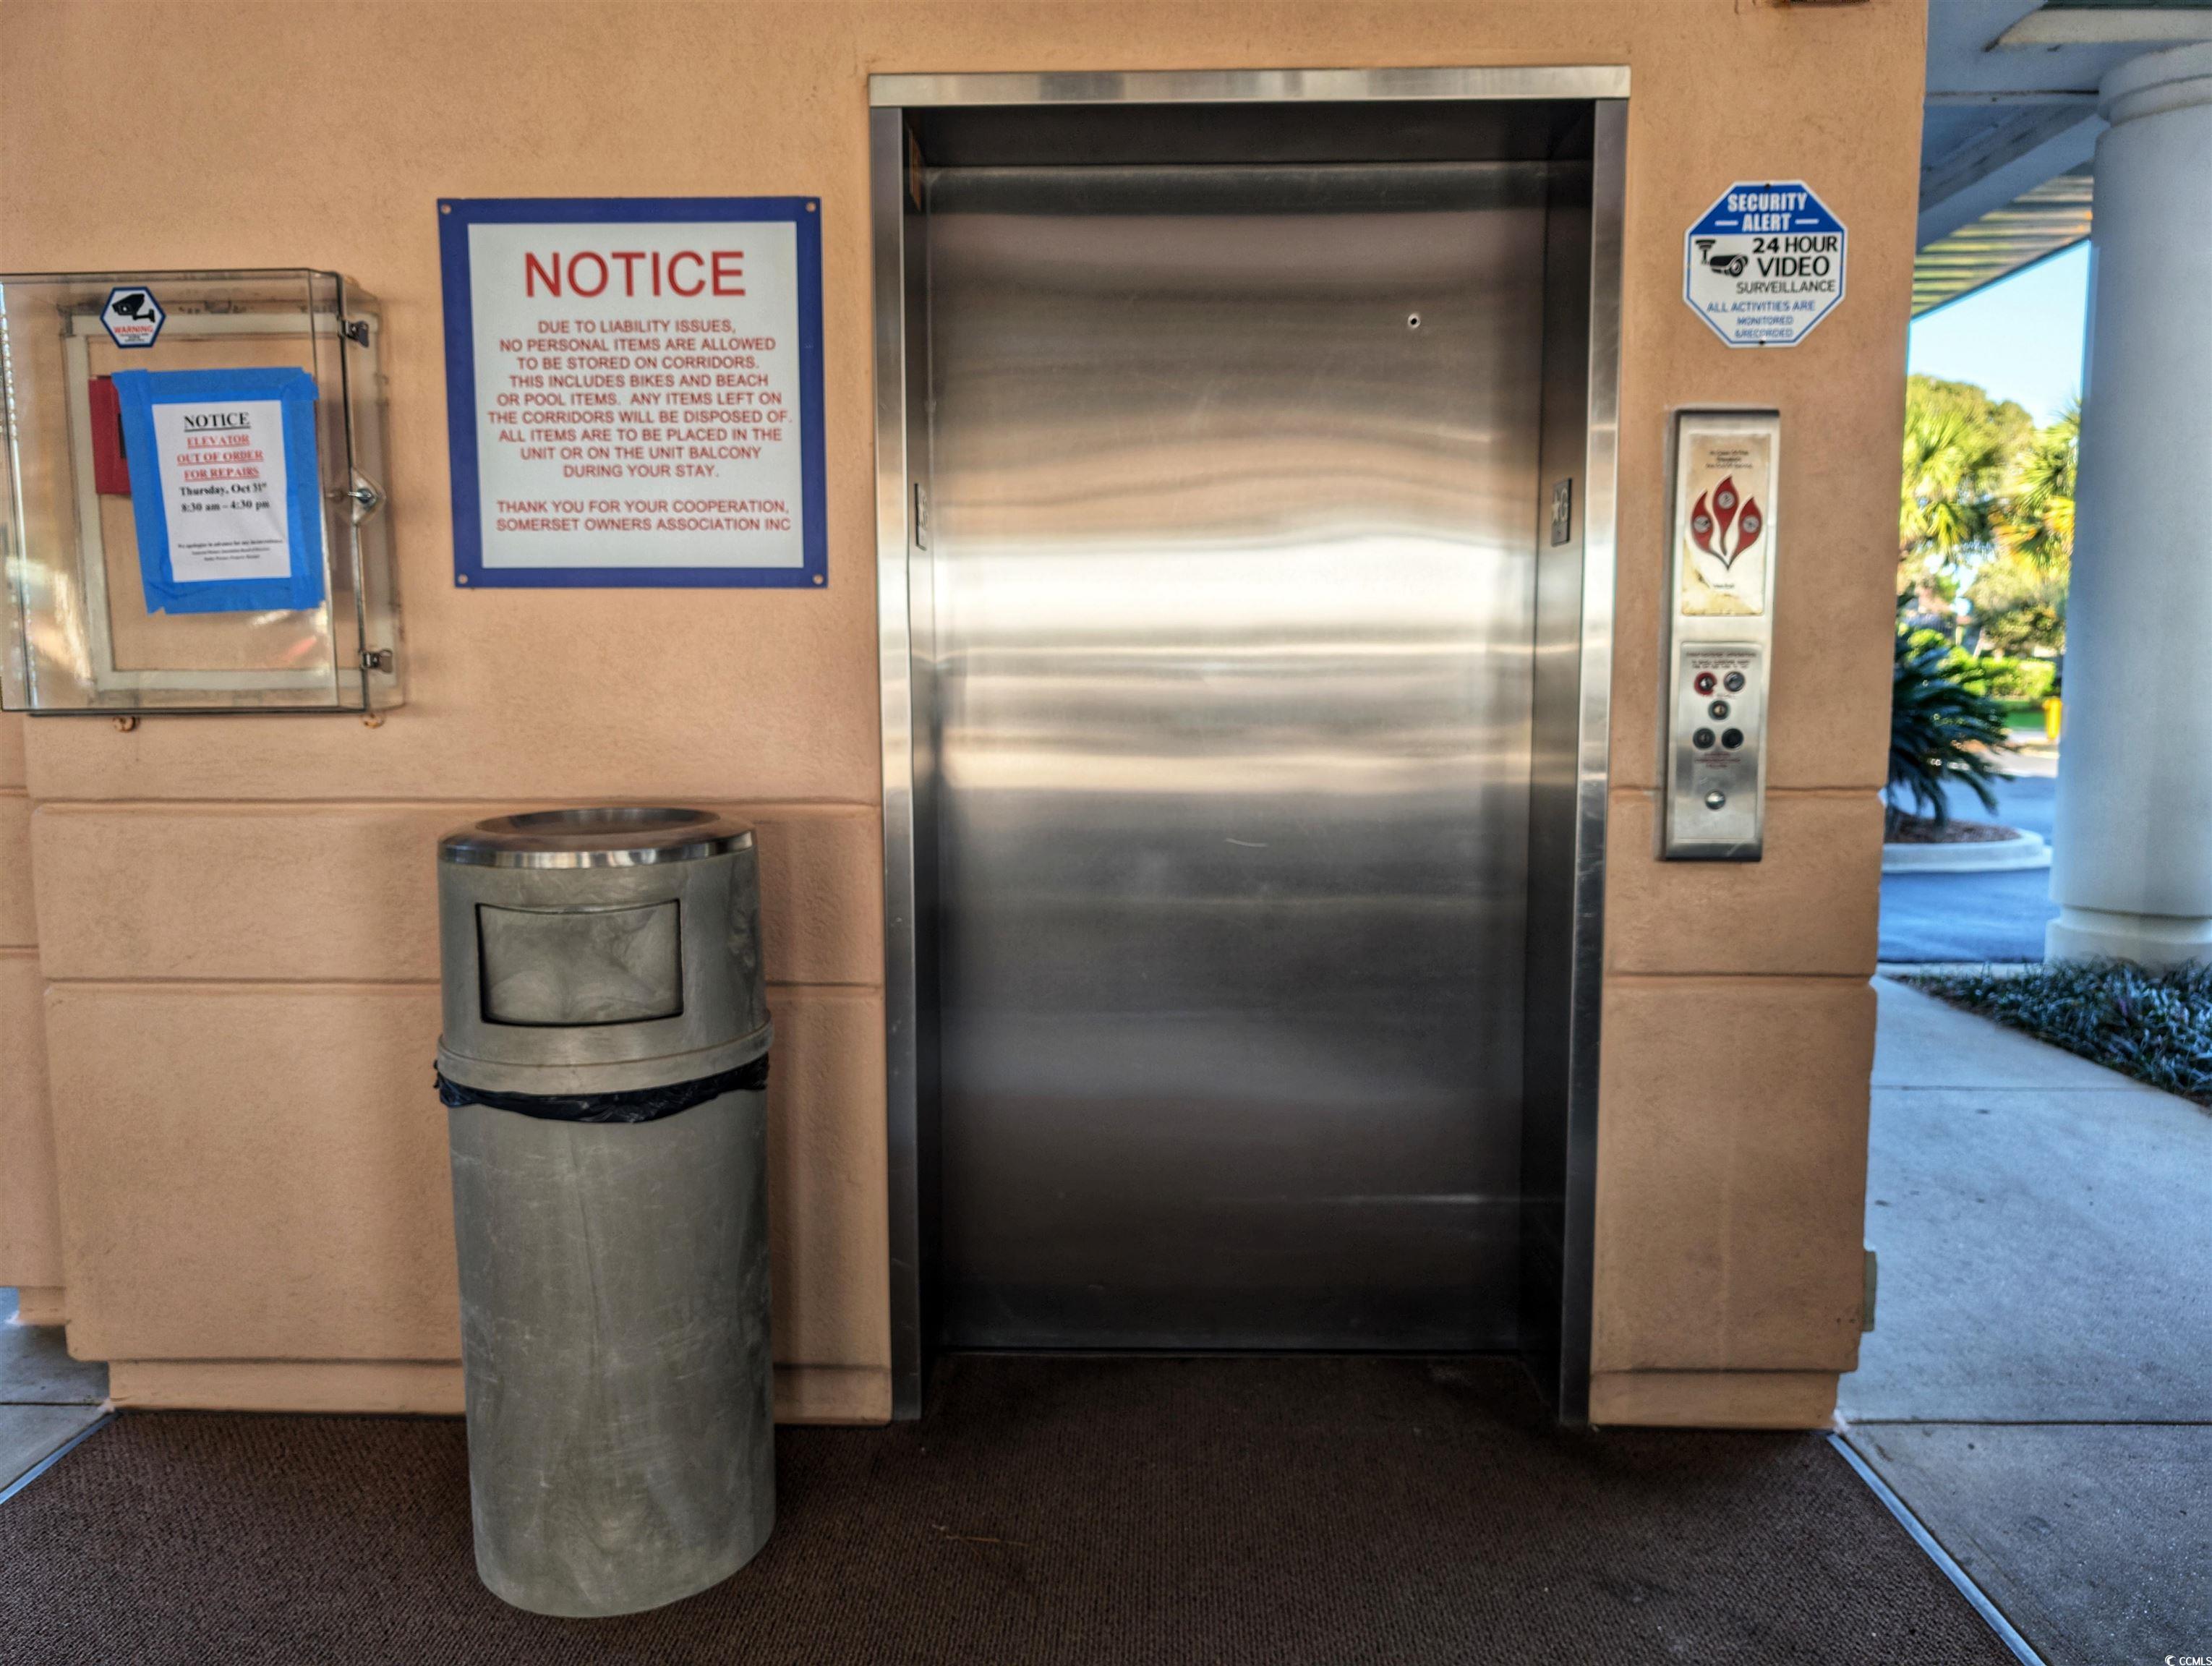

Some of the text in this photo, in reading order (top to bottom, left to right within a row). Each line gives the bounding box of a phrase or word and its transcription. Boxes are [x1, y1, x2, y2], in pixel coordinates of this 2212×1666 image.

[1727, 192, 1807, 213] SECURITY
[1741, 213, 1792, 232] ALERT
[1752, 235, 1838, 255] 24 HOUR
[1757, 255, 1830, 277] VIDEO
[524, 249, 747, 298] NOTICE
[1736, 279, 1836, 294] SURVEILLANCE
[1707, 299, 1816, 313] ALL ACTIVITIES ARE
[538, 320, 569, 333] DUE
[575, 320, 596, 333] TO
[600, 320, 669, 333] LIABILITY
[1737, 315, 1794, 325] MONITORED
[114, 324, 153, 333] WARNING
[500, 337, 776, 352] NO PERSONAL ITEMS ARE ALLOWED
[517, 356, 537, 369] TO
[542, 356, 561, 369] BE
[567, 356, 630, 369] STORED
[634, 356, 658, 369] ON
[509, 374, 769, 388] THIS INCLUDES BIKES AND BEACH
[497, 392, 519, 406] OR
[524, 392, 565, 406] POOL
[630, 392, 660, 406] ANY
[666, 392, 712, 406] ITEMS
[717, 392, 754, 406] LEFT
[759, 392, 782, 406] ON
[184, 411, 251, 430] NOTICE
[488, 409, 517, 424] THE
[522, 409, 614, 424] CORRIDORS
[618, 409, 654, 424] WILL
[658, 409, 678, 424] BE
[683, 409, 762, 424] DISPOSED
[187, 434, 250, 449] ELEVATOR
[499, 427, 782, 442] ALL ITEMS ARE TO BE PLACED IN THE
[176, 450, 264, 466] OUT OF ORDER
[521, 446, 761, 460] UNIT OR ON THE UNIT BALCONY
[184, 466, 260, 482] FOR REPAIRS
[563, 464, 623, 478] DURING
[628, 464, 672, 478] YOUR
[231, 483, 251, 494] Oct
[205, 503, 221, 512] am
[230, 500, 252, 510] 4:30
[255, 500, 270, 512] pm
[497, 500, 548, 513] THANK
[552, 500, 585, 513] YOU
[588, 500, 620, 513] FOR
[624, 500, 669, 513] YOUR
[496, 518, 791, 531] SOMERSET OWNERS ASSOCIATION INC
